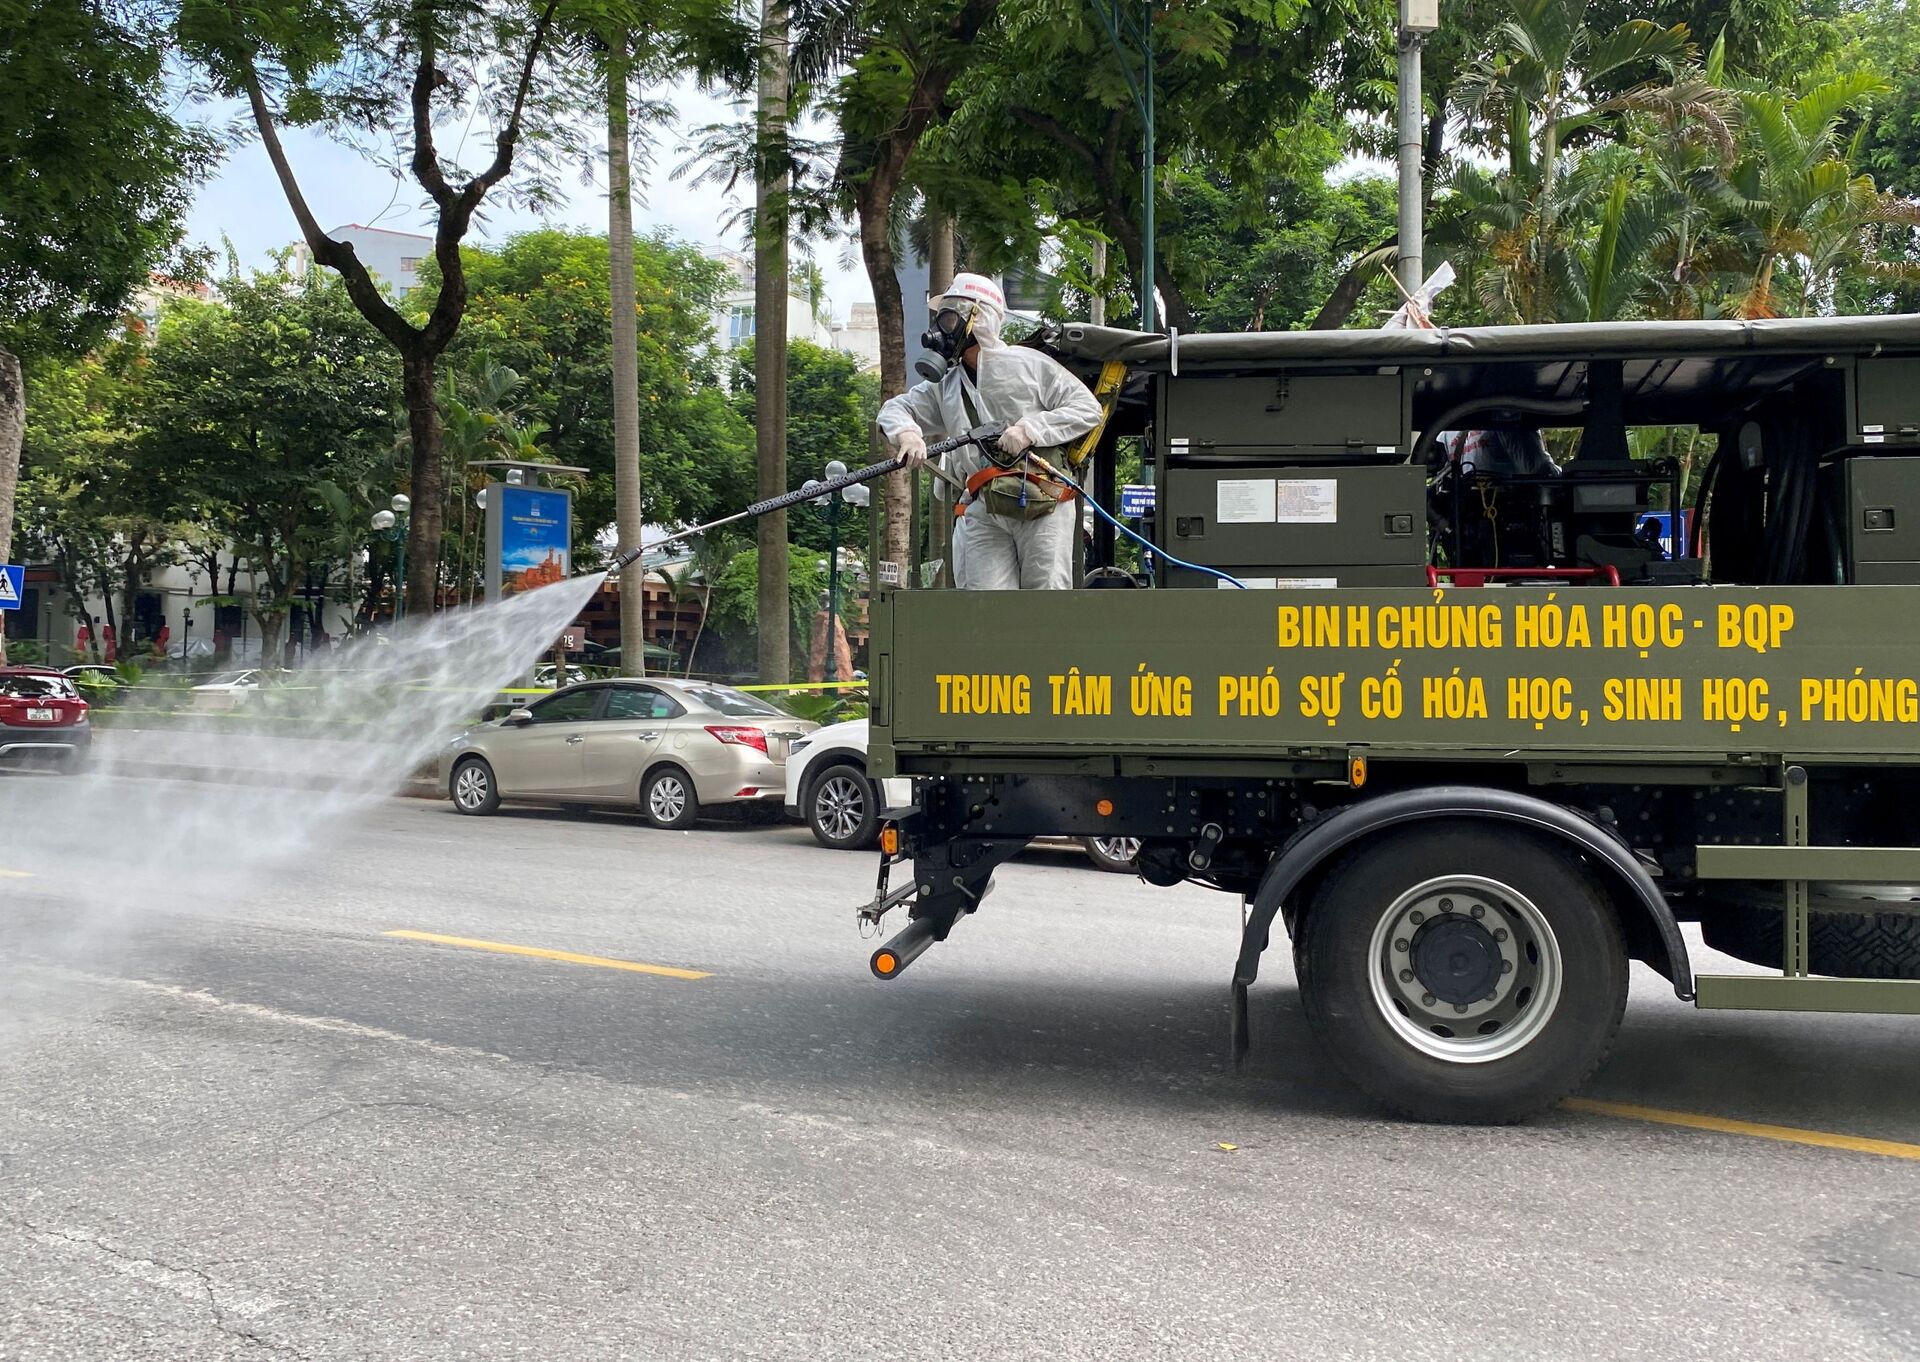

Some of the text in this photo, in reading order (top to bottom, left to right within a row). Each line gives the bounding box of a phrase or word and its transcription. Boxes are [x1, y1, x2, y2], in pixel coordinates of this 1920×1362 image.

[1278, 604, 1371, 648] BINH
[1377, 589, 1502, 650] CHỦNG
[1515, 592, 1592, 649] HÓA
[1602, 603, 1685, 659] HỌC
[1717, 603, 1796, 654] BQP
[935, 674, 1031, 715] TRUNG
[1048, 666, 1112, 716] TÂM
[1130, 663, 1193, 717] ỨNG
[1218, 666, 1281, 717] PHÓ
[1300, 671, 1346, 727] SỰ
[1361, 658, 1403, 720] CỐ
[1422, 667, 1489, 720] HÓA
[1602, 677, 1683, 722] SINH
[1800, 668, 1919, 724] PHÓNG
